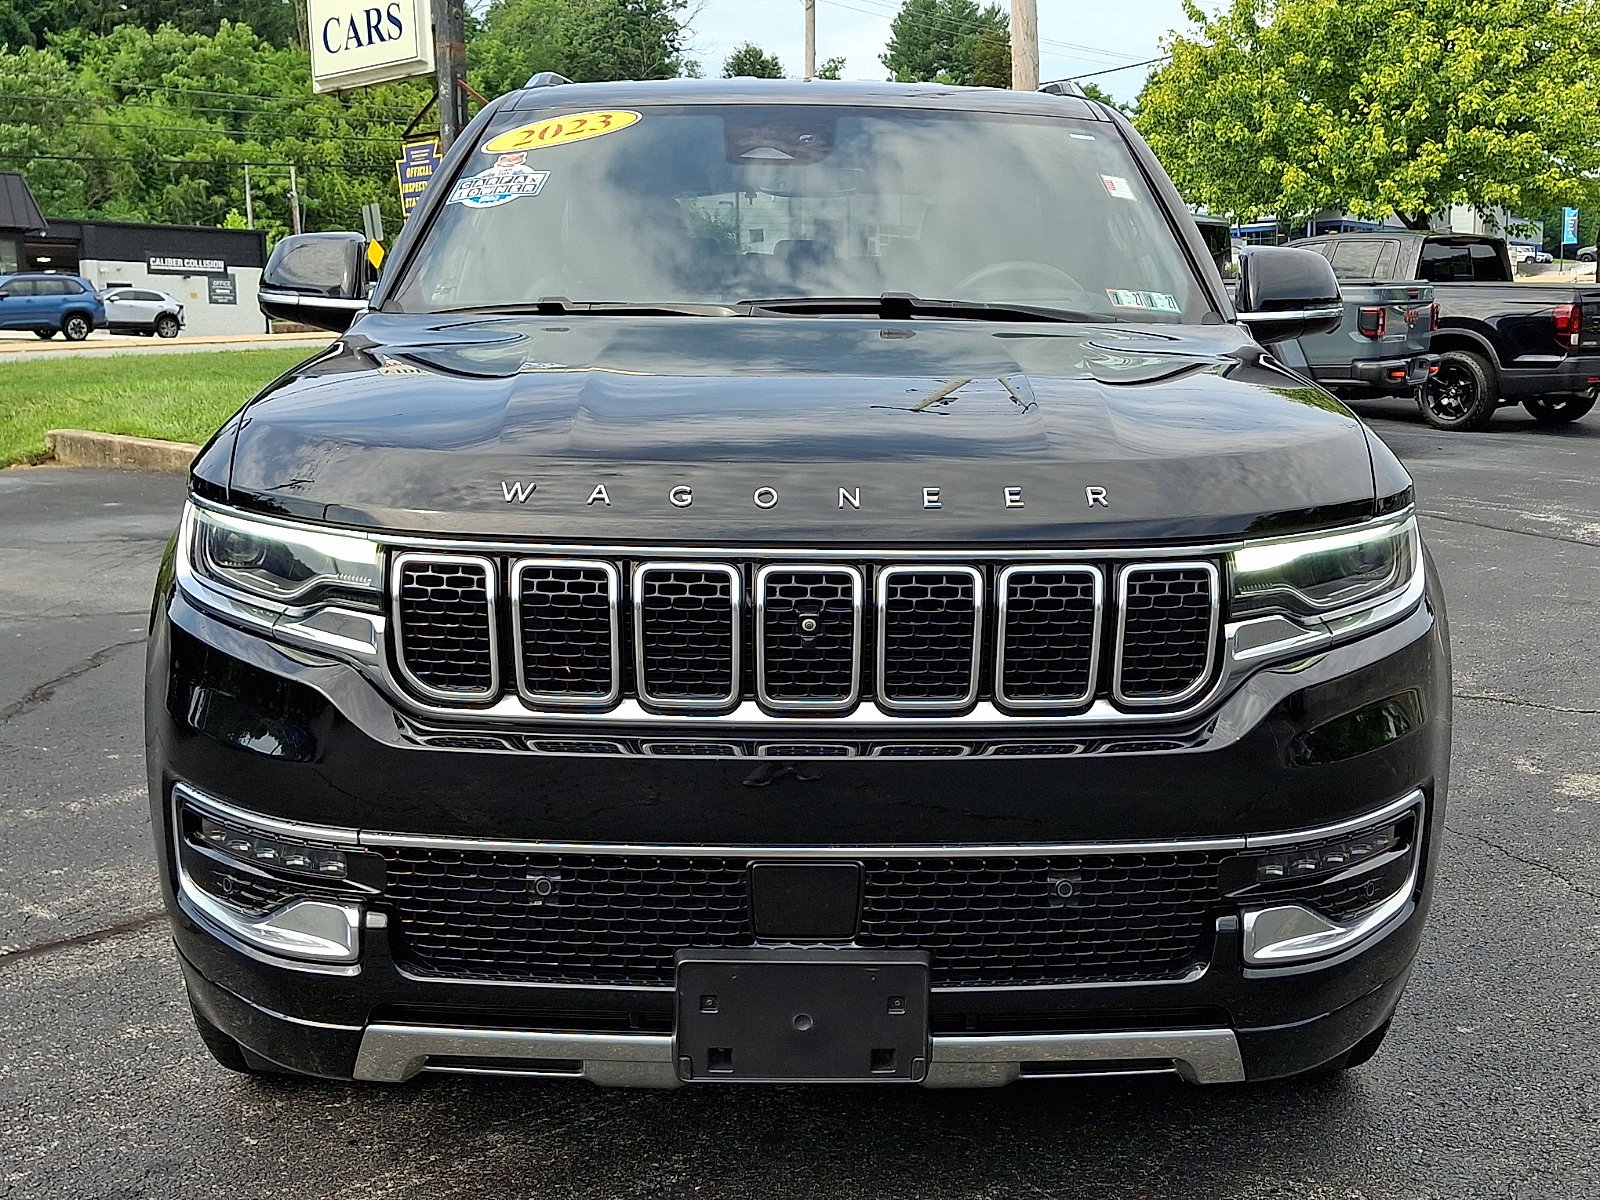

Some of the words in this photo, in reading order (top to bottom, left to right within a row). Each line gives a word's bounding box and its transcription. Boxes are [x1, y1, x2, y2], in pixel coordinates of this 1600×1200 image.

[322, 2, 403, 54] CARS
[512, 114, 613, 147] 2023
[406, 164, 433, 178] OFFICIAL
[402, 181, 428, 193] INSPECT
[460, 175, 540, 190] CARFAX
[149, 257, 183, 267] CALIBER
[184, 259, 224, 269] COLLISION
[500, 481, 1109, 508] WAGONEER
